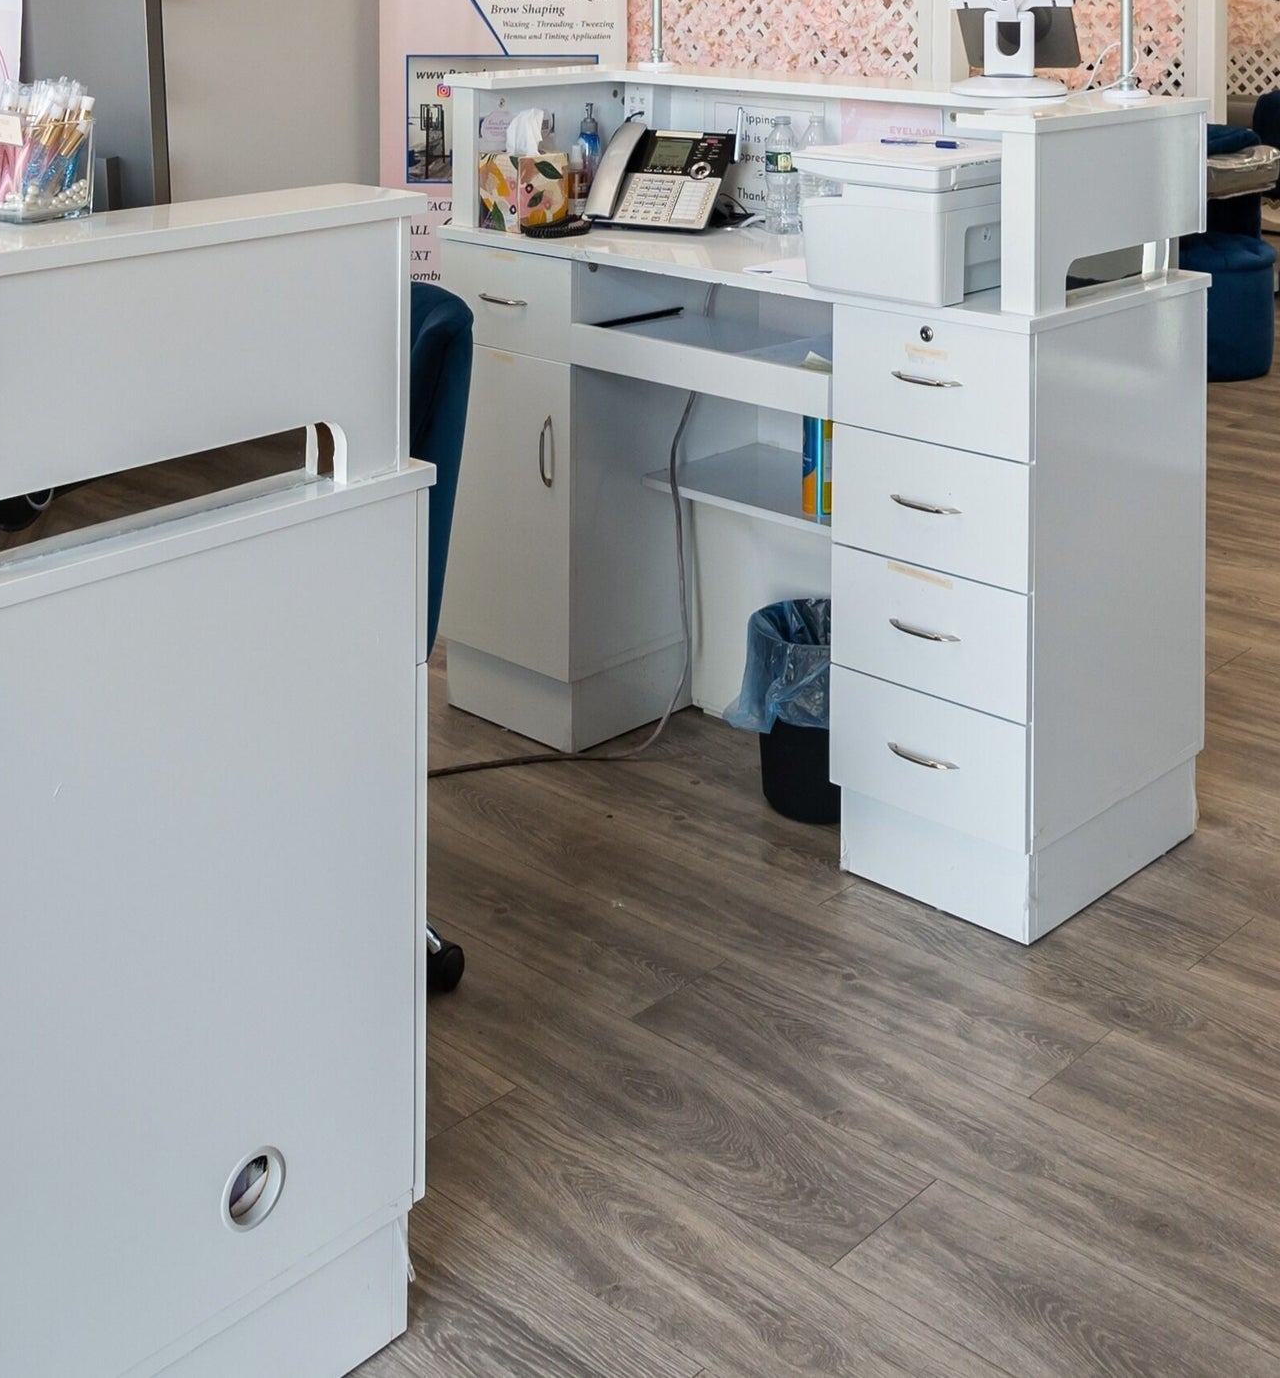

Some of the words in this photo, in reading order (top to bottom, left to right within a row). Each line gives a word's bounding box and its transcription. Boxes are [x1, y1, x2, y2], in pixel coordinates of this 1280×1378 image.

[490, 4, 519, 14] Brow
[521, 4, 565, 16] Shaping
[502, 20, 530, 29] Waxing
[537, 20, 574, 29] Threading
[581, 21, 615, 29] Tweezing
[544, 33, 569, 41] Tinting
[570, 33, 611, 41] Application
[740, 110, 776, 127] ipping
